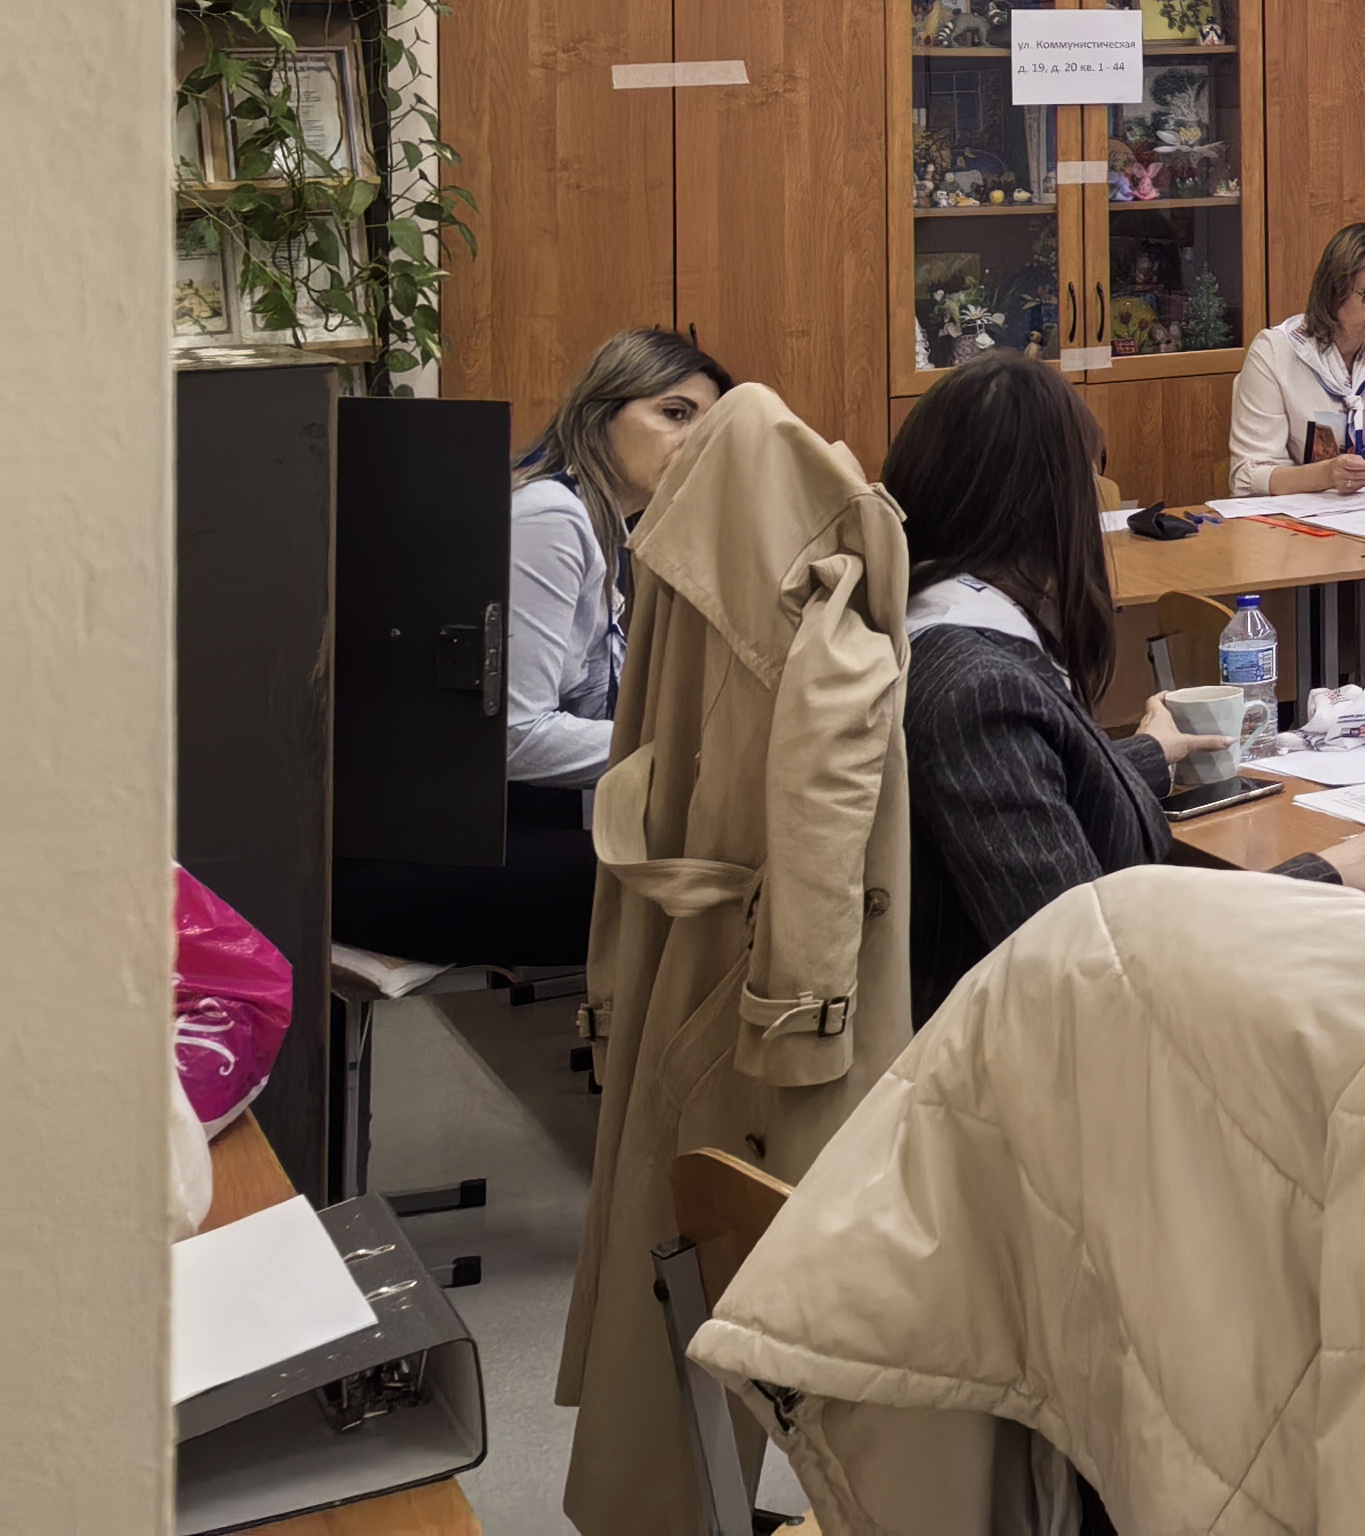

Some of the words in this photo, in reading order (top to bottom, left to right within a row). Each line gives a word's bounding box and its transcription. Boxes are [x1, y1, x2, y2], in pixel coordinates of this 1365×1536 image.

[1017, 41, 1033, 51] ул.
[1036, 40, 1136, 51] Коммунистическая
[1017, 65, 1029, 74] д.
[1031, 63, 1048, 74] 19,
[1050, 64, 1061, 74] д.
[1064, 62, 1078, 72] 20
[1098, 62, 1104, 72] 1
[1112, 61, 1125, 72] 44
